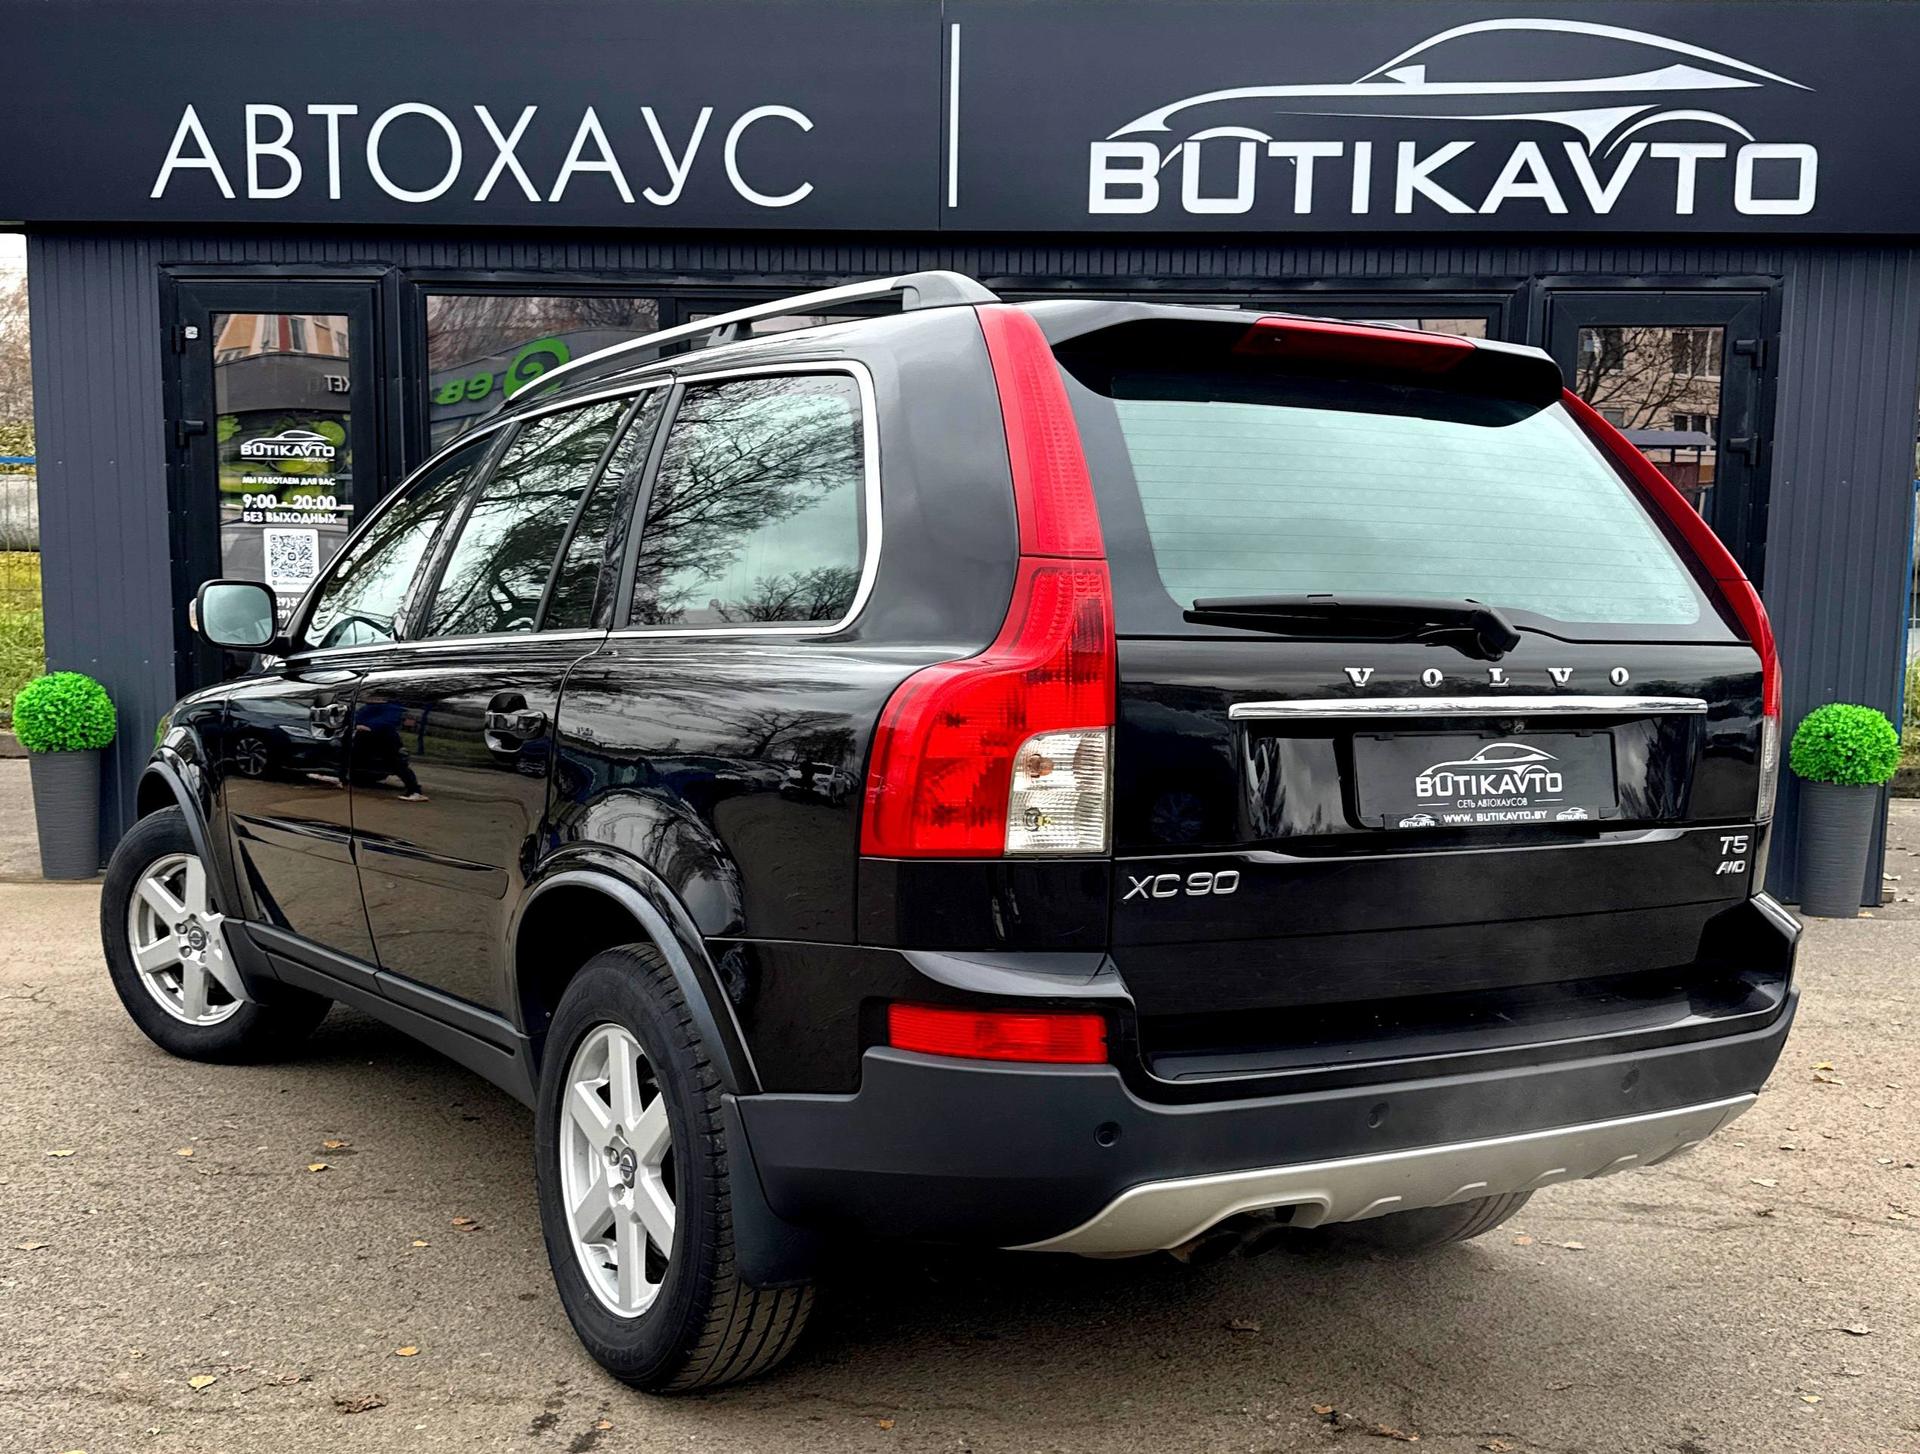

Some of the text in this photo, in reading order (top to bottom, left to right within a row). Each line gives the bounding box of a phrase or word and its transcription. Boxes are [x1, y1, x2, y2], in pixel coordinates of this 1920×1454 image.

[151, 103, 814, 208] АВТОХАУС
[1088, 140, 1819, 215] BUTIKAVTO
[240, 443, 335, 457] BUTIKAVTO
[242, 476, 336, 486] МЫ РАБОТАЕМ ДЛЯ ВАС
[242, 493, 277, 509] 9:00
[292, 495, 337, 510] 20:00
[243, 511, 337, 524] БЕЗ ВЫХОДНЫХ
[1344, 667, 1630, 688] VOLVO
[1416, 773, 1563, 797] BUTIKAVTO
[1457, 797, 1528, 809] СЕТЬ АВТОХАУСОВ
[1443, 810, 1548, 823] WWW. BUTIKAVTO.BY
[1720, 835, 1749, 855] T5
